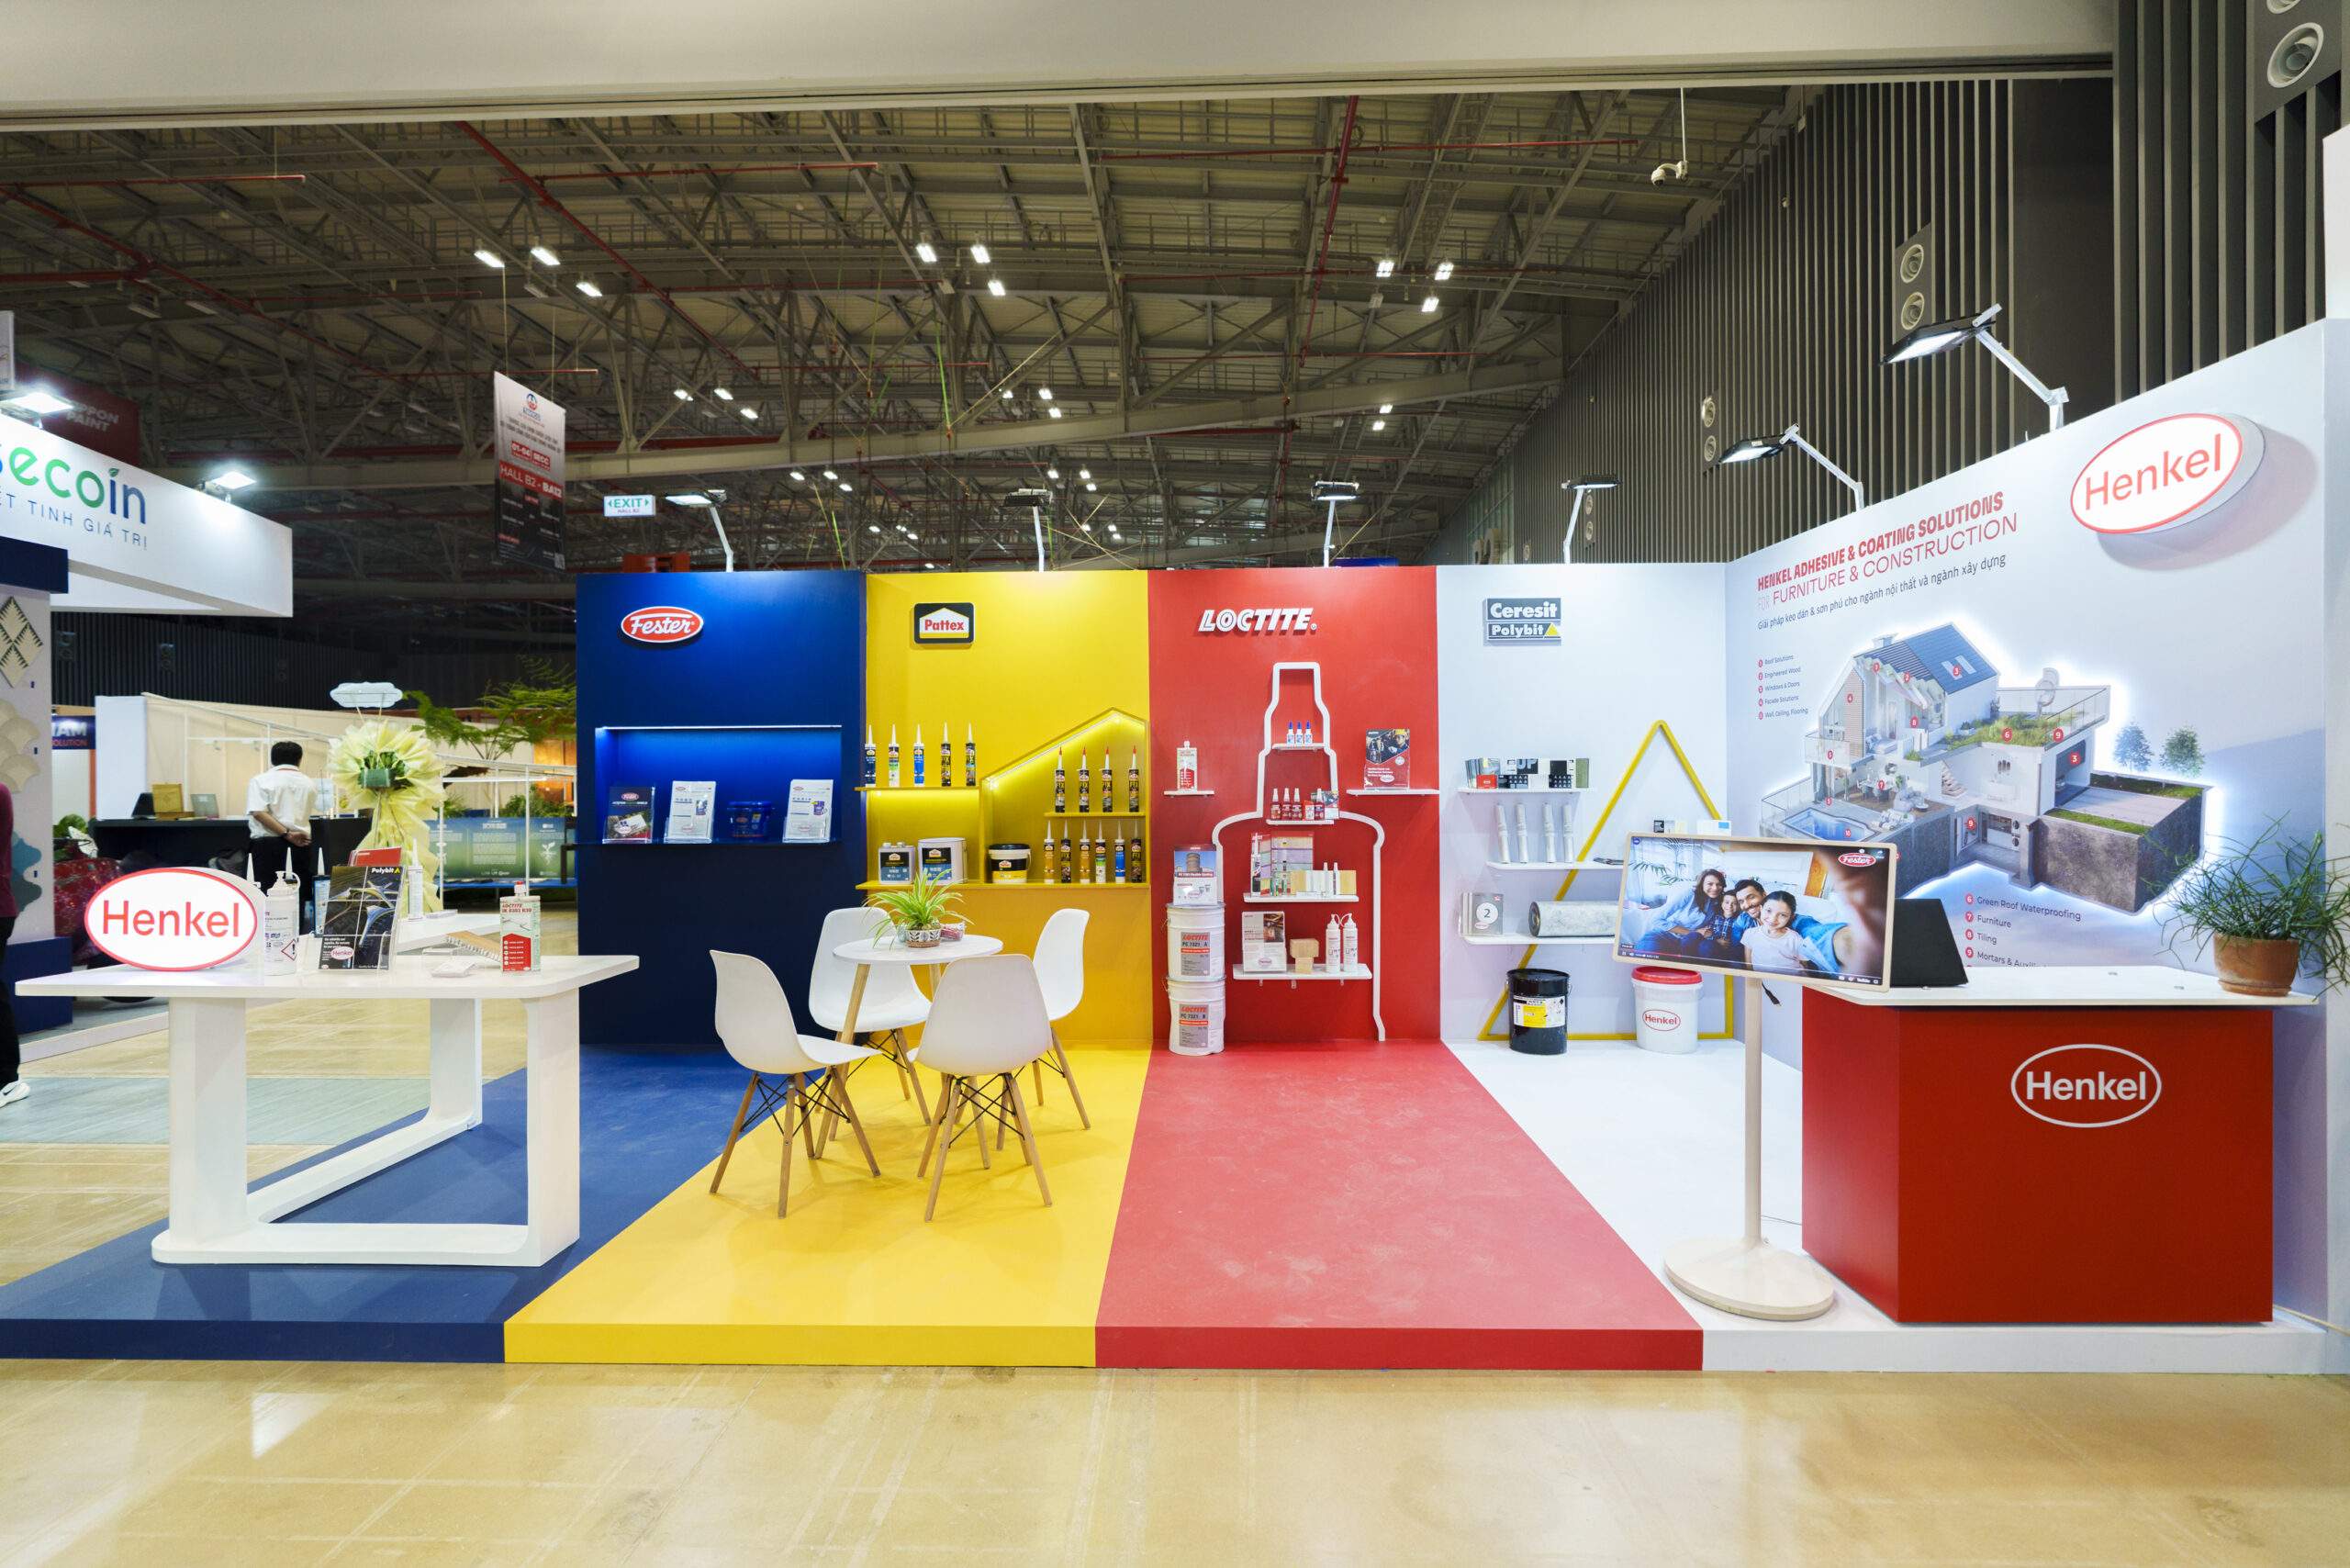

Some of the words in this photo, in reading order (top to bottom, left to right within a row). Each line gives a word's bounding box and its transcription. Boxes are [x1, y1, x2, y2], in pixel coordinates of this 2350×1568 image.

[66, 410, 110, 431] PAINT
[499, 464, 524, 483] HALL
[2085, 432, 2221, 510] Henkel
[0, 446, 146, 524] ecoin
[614, 498, 643, 508] EXIT
[28, 499, 73, 526] TINH
[84, 517, 113, 538] GIÁ
[121, 529, 148, 551] TRỊ
[1757, 567, 1792, 591] HENKEL
[1793, 548, 1845, 580] ADHESIVE
[1847, 545, 1855, 561] &
[1858, 523, 1915, 557] COATING
[1918, 491, 2004, 537] SOLUTIONS
[1773, 569, 1845, 604] FURNITURE
[1849, 566, 1859, 582] &
[1863, 512, 2018, 577] CONSTRUCTION
[1809, 607, 1816, 616] &
[1844, 595, 1858, 607] cho
[1859, 588, 1884, 604] ngành
[1886, 581, 1898, 598] nội
[1899, 576, 1917, 593] thất
[1919, 575, 1929, 588] và
[1930, 566, 1959, 585] ngành
[1962, 561, 1978, 576] xây
[1980, 554, 2007, 572] dựng
[1490, 600, 1558, 619] Ceresit
[630, 612, 693, 635] Fester
[924, 619, 965, 631] Pattex
[1198, 607, 1314, 632] LOCTITE
[1491, 622, 1544, 637] Polybit
[1779, 695, 1799, 703] Solutions
[52, 738, 88, 747] OLUTION
[371, 867, 395, 875] Polybit
[103, 900, 241, 937] Henkel
[1483, 908, 1491, 918] 2
[1976, 896, 1999, 907] Green
[2000, 900, 2019, 910] Roof
[2020, 903, 2082, 922] Waterproofing
[1976, 914, 2012, 928] Furniture
[1976, 932, 1998, 946] Tiling
[1976, 951, 2006, 965] Mortars
[2007, 958, 2013, 966] &
[1644, 1014, 1680, 1026] Henkel
[2026, 1070, 2146, 1101] Henkel
